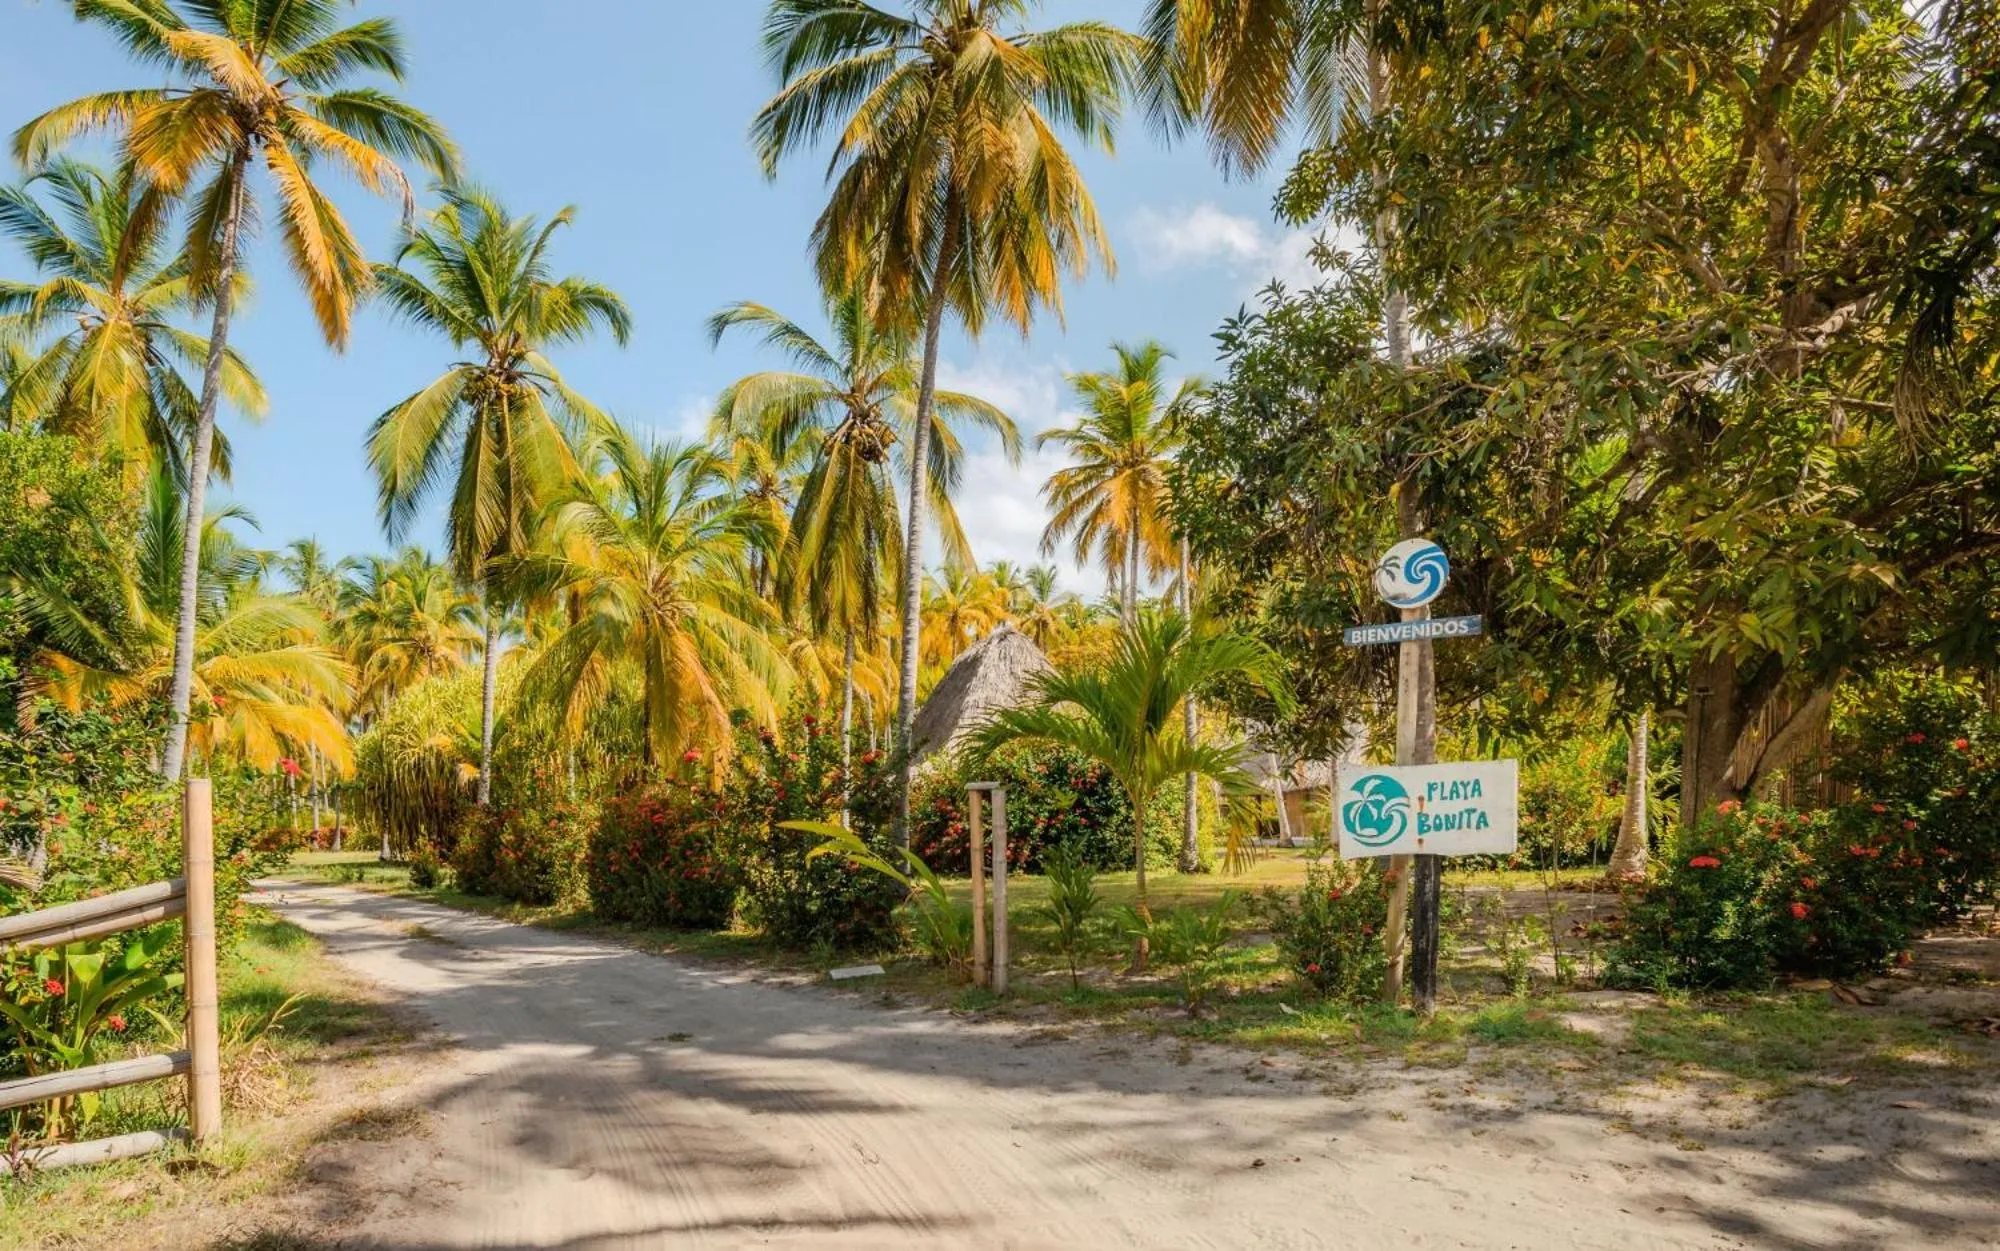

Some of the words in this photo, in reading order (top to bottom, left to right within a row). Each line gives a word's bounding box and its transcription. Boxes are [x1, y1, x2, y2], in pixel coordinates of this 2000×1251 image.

[1351, 619, 1469, 644] BIENVENIDOS
[1426, 778, 1482, 802] PLAYA
[1417, 807, 1489, 835] BONITA
